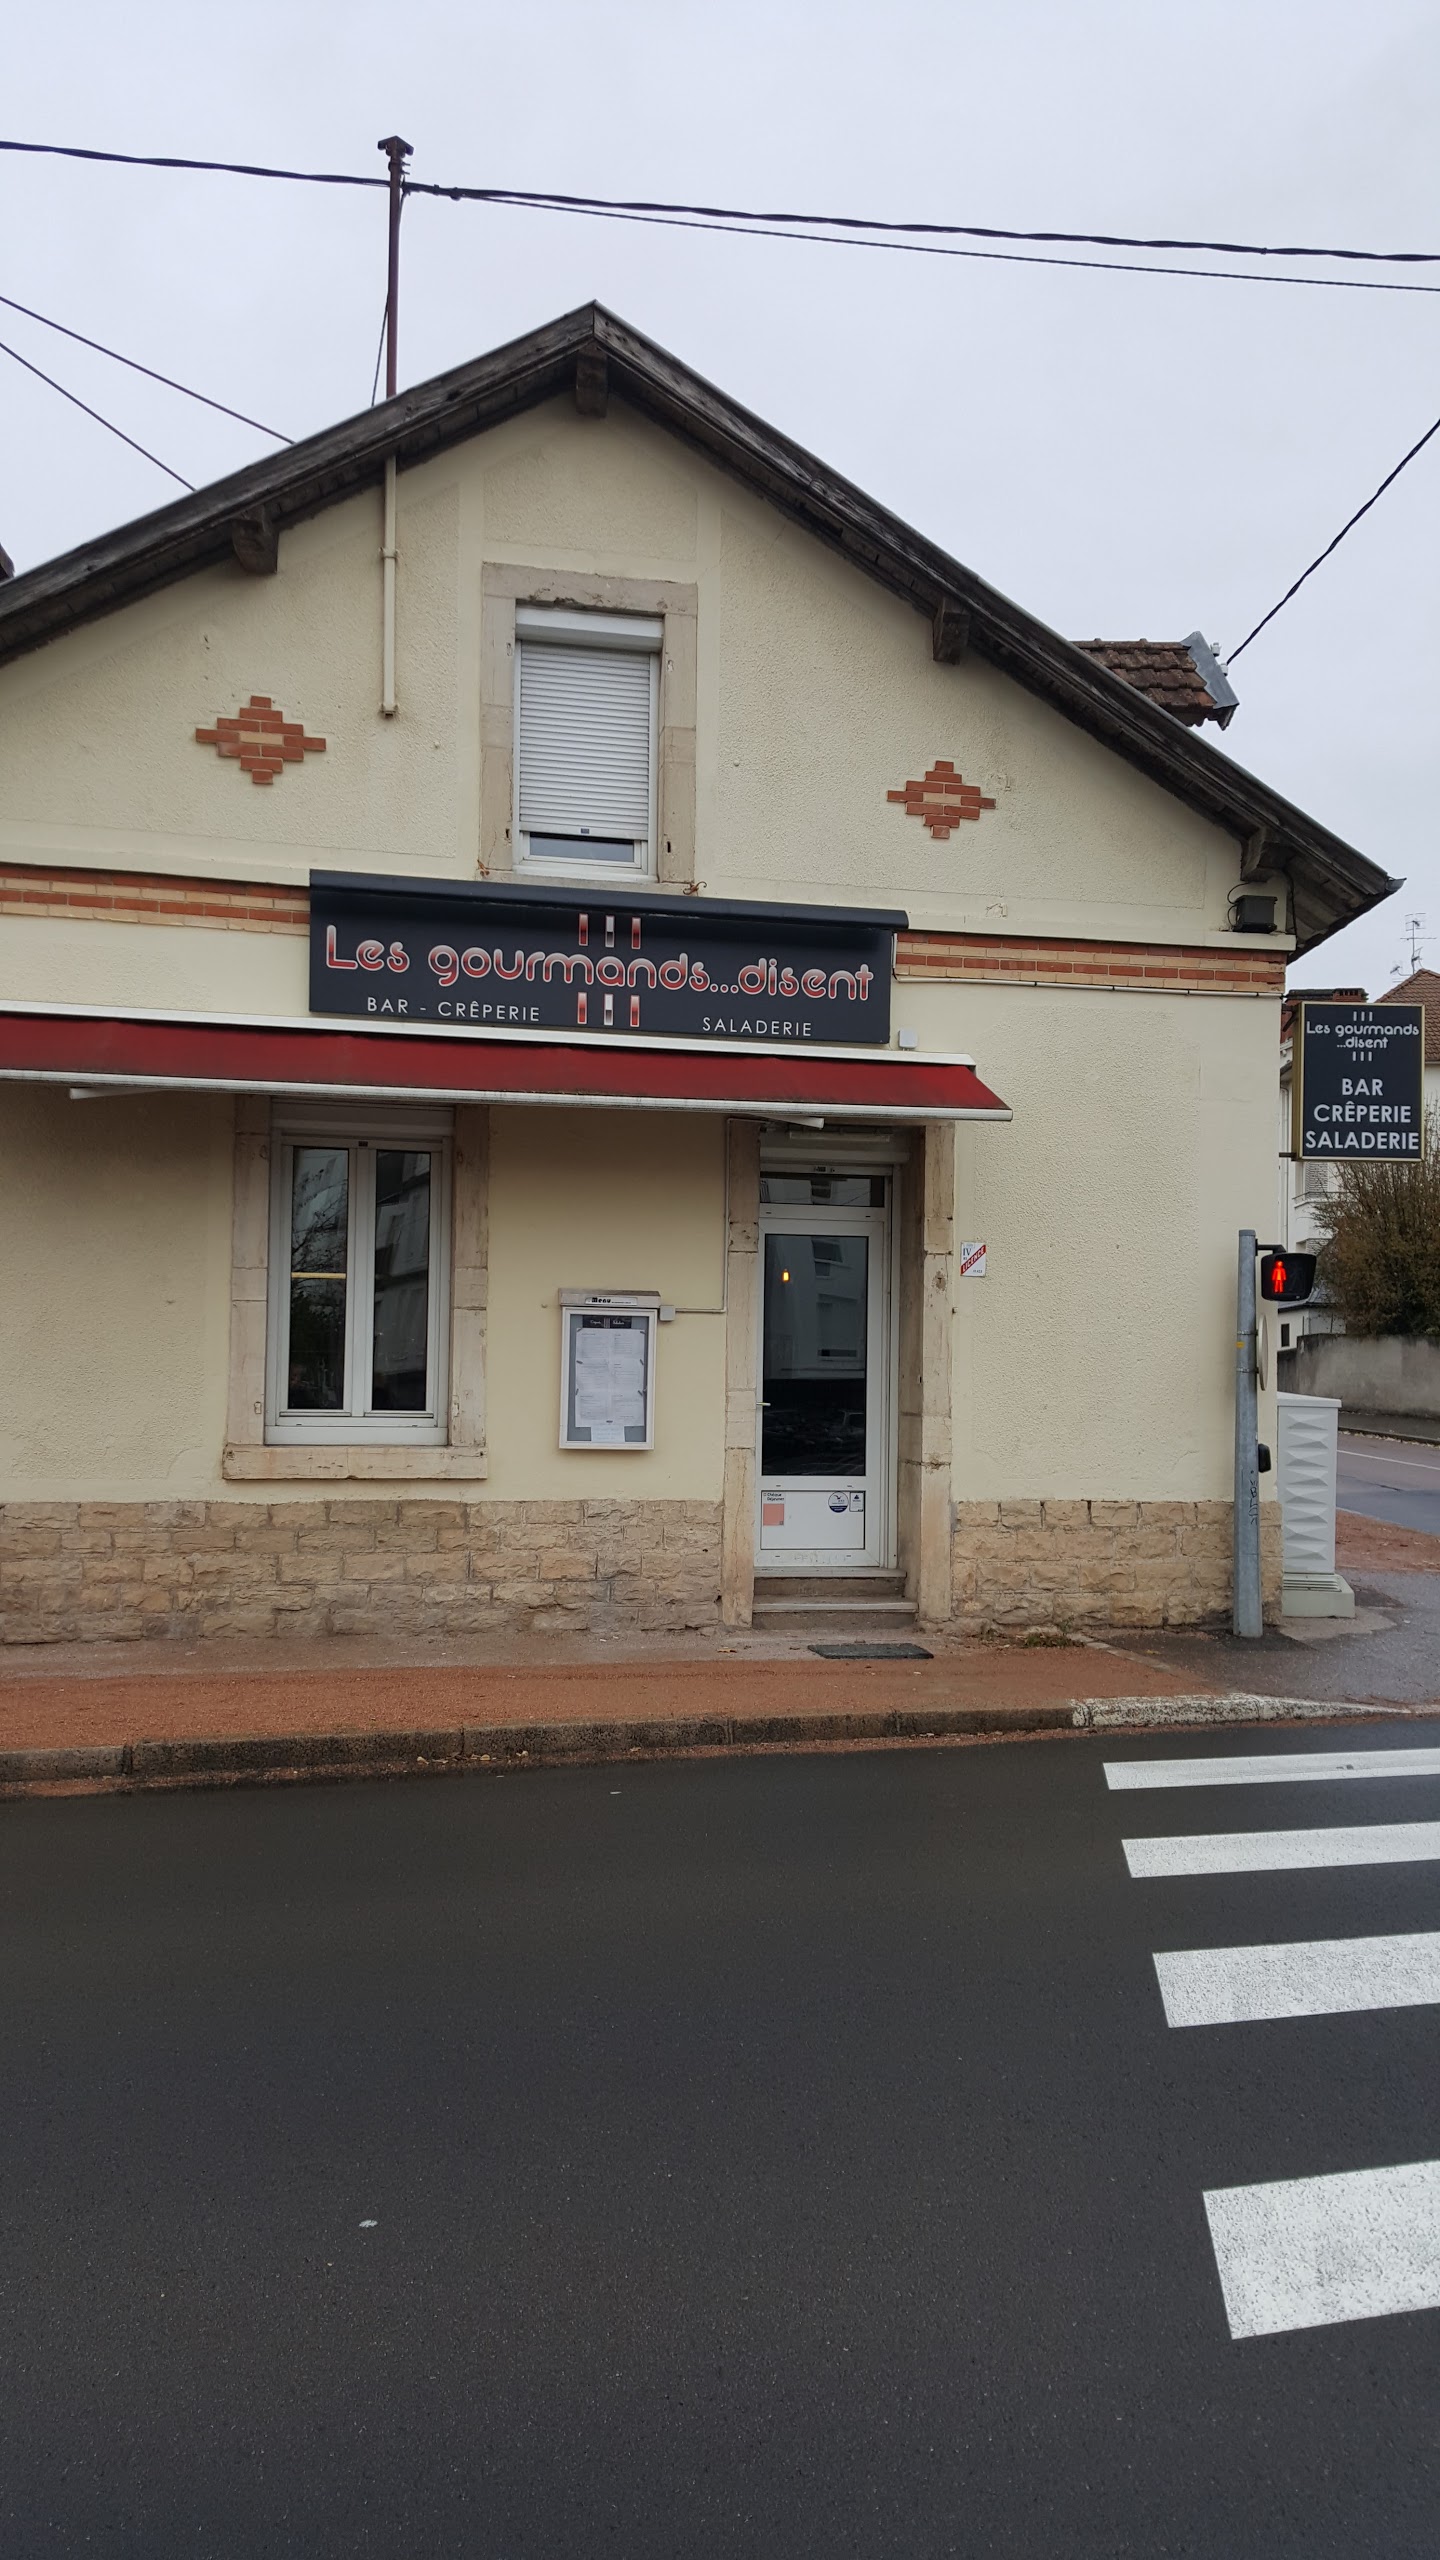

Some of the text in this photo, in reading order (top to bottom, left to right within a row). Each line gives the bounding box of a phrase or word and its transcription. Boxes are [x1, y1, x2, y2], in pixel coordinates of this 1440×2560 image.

[326, 924, 410, 972] Les
[367, 996, 408, 1015] BAR
[438, 1000, 540, 1022] CRÊPERIE
[702, 1016, 812, 1037] SALADERIE
[1306, 1021, 1420, 1037] Les gourmands
[1341, 1078, 1384, 1096] BAR
[1313, 1101, 1412, 1123] CRÊPERIE
[1305, 1131, 1419, 1150] SALADERIE
[963, 1246, 984, 1272] LICENCE
